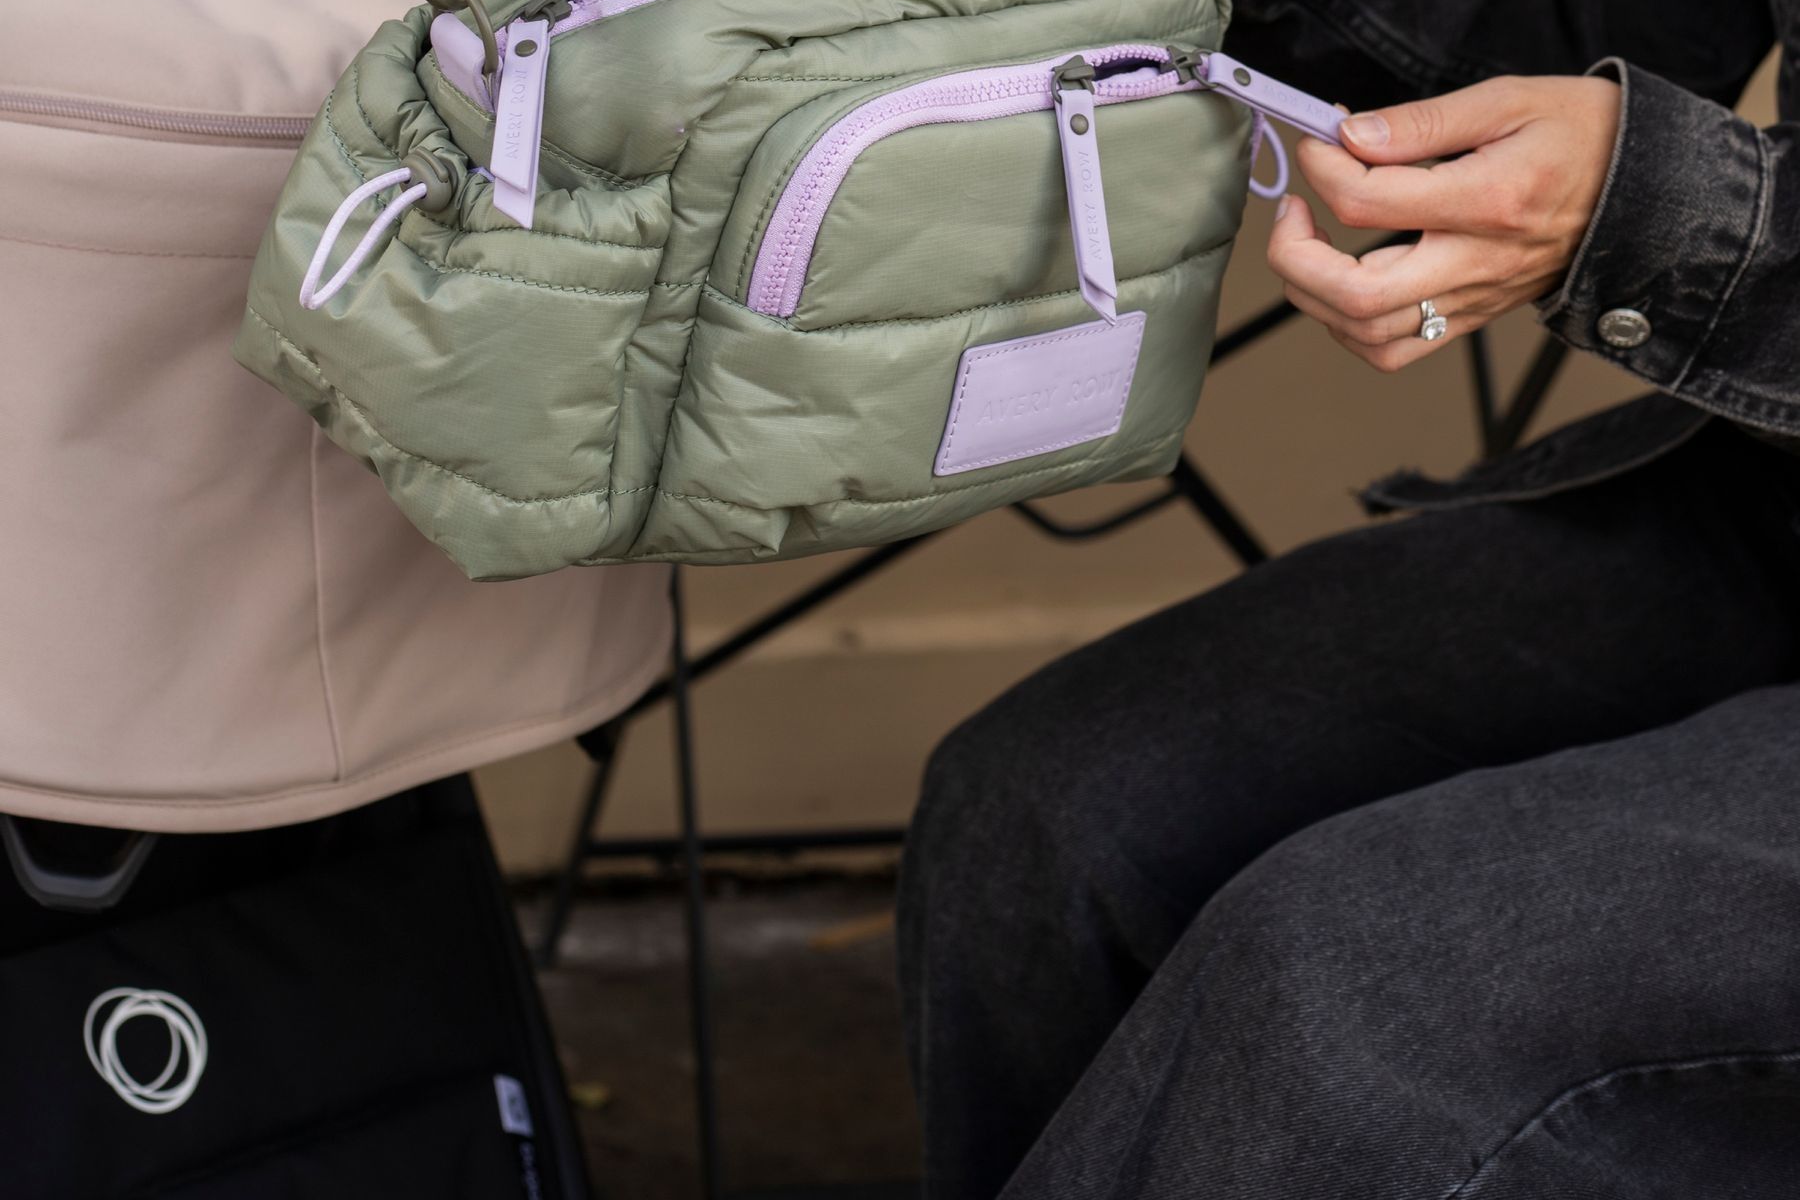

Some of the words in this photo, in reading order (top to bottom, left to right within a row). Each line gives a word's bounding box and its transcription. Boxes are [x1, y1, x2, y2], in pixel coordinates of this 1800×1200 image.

[509, 69, 529, 104] ROW
[503, 112, 524, 160] AVERY
[1077, 150, 1094, 193] ROW
[1083, 200, 1102, 261] AVERY
[975, 384, 1059, 426] AVERY
[1066, 370, 1121, 407] ROW
